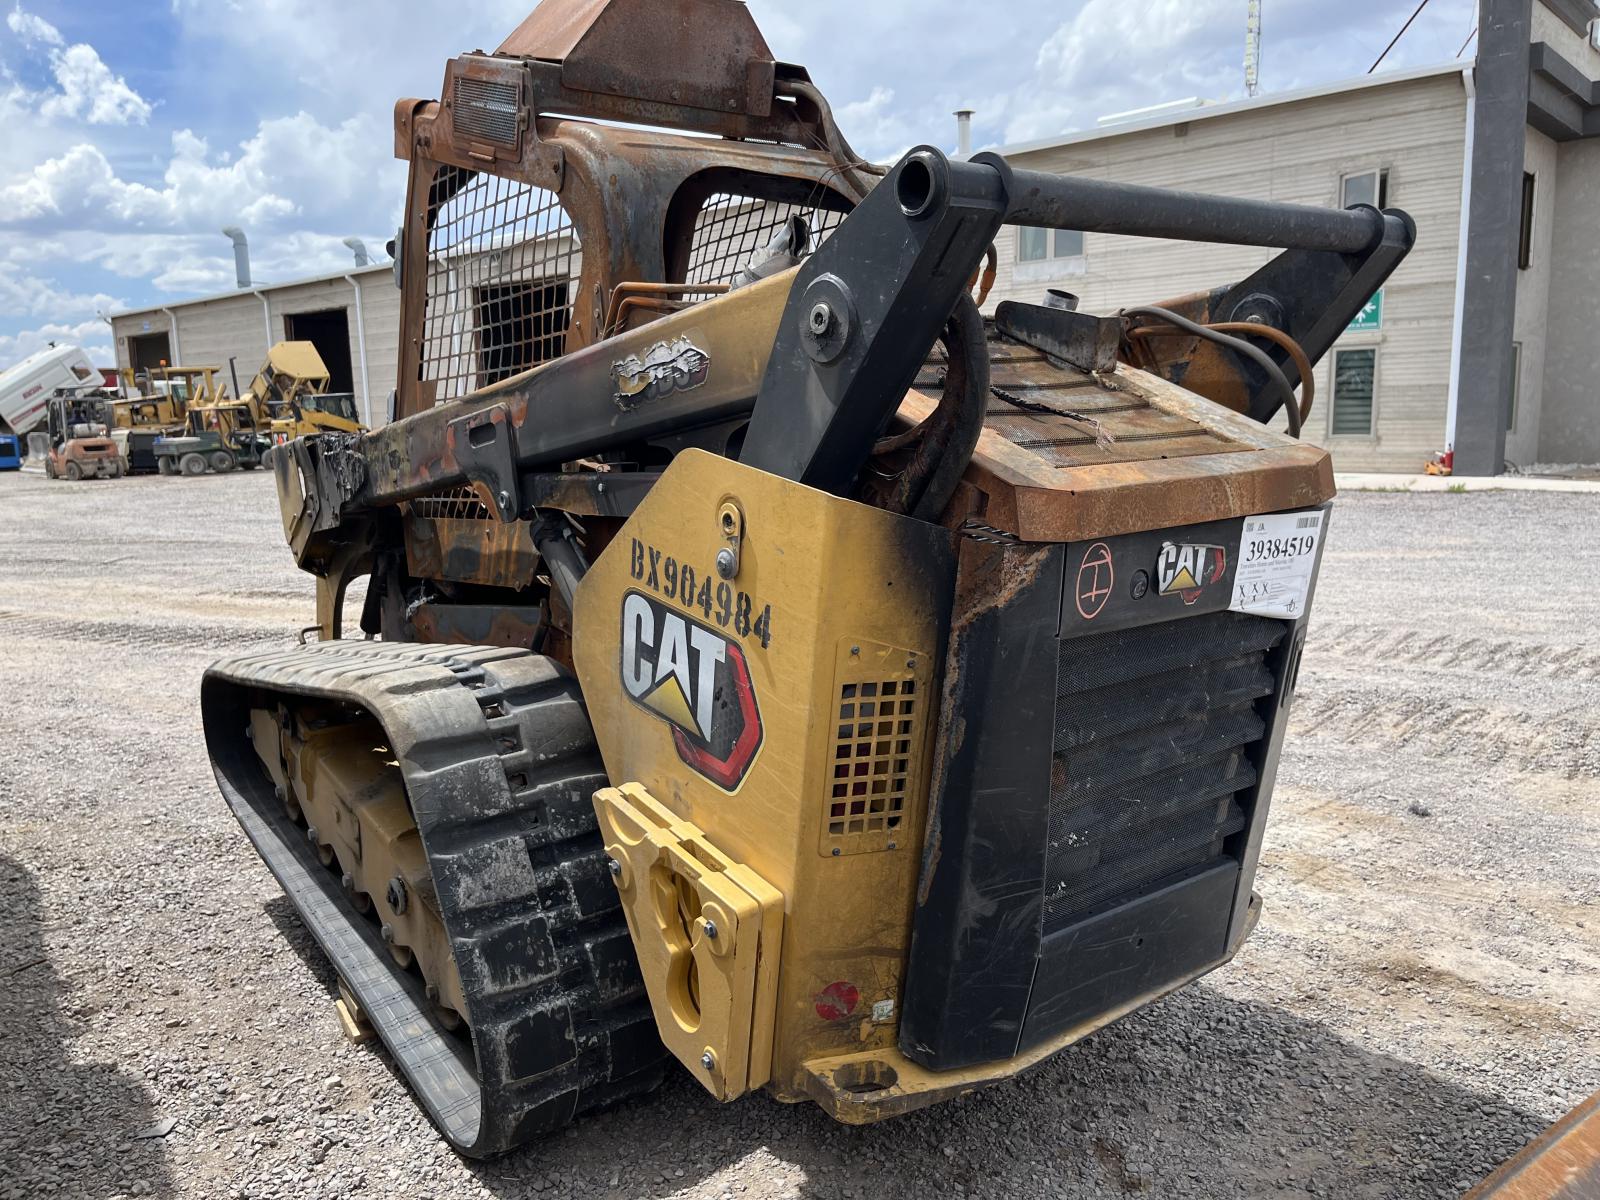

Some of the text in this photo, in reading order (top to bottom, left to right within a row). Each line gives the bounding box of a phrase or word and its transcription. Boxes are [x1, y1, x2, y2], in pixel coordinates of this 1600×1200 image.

[1158, 543, 1207, 593] CAT
[1246, 535, 1314, 562] 39384519
[631, 537, 771, 650] BX904984
[622, 594, 727, 743] CAT
